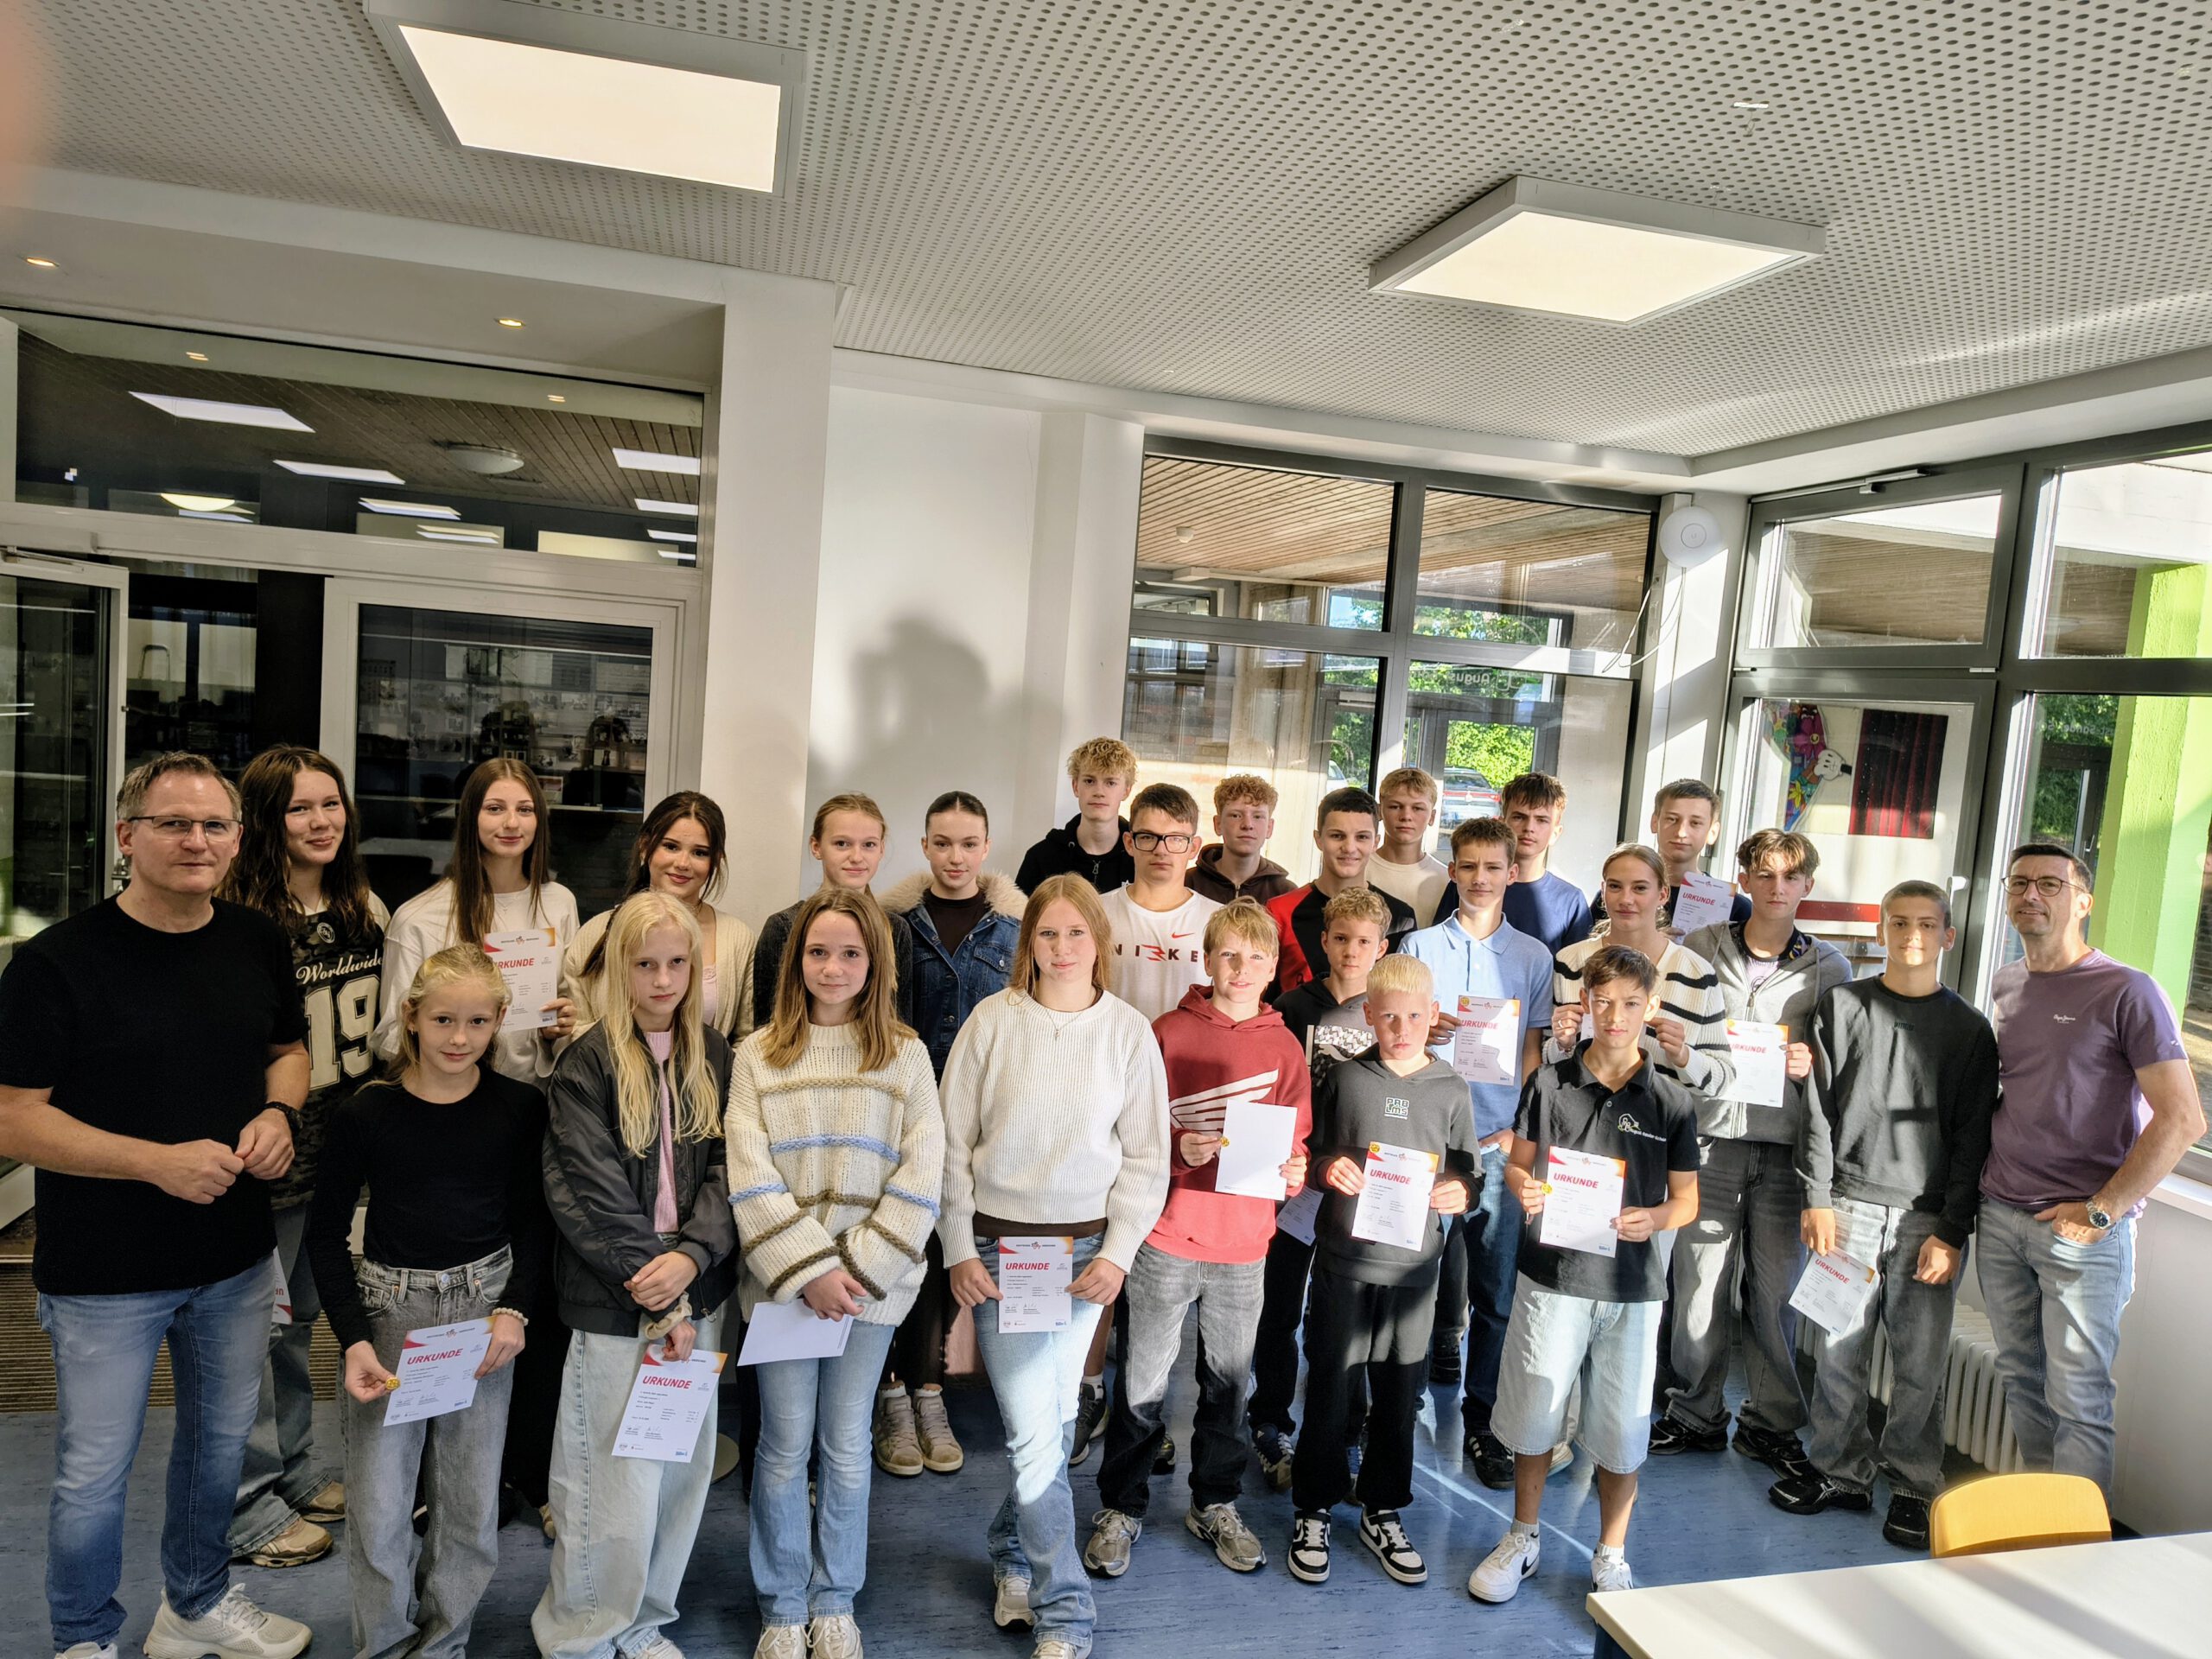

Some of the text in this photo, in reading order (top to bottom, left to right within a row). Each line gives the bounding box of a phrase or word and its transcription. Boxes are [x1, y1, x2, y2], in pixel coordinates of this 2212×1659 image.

[1682, 892, 1716, 906] URKUNDE
[495, 957, 535, 969] RKUNDE
[305, 975, 380, 1090] 19
[1460, 1020, 1499, 1030] URKUNDE
[1370, 1168, 1412, 1185] URKUNDE
[1553, 1173, 1599, 1189] URKUNDE
[1815, 1258, 1850, 1284] URKUNDE
[407, 1348, 464, 1365] URKUNDE
[642, 1375, 693, 1389] URKUNDE
